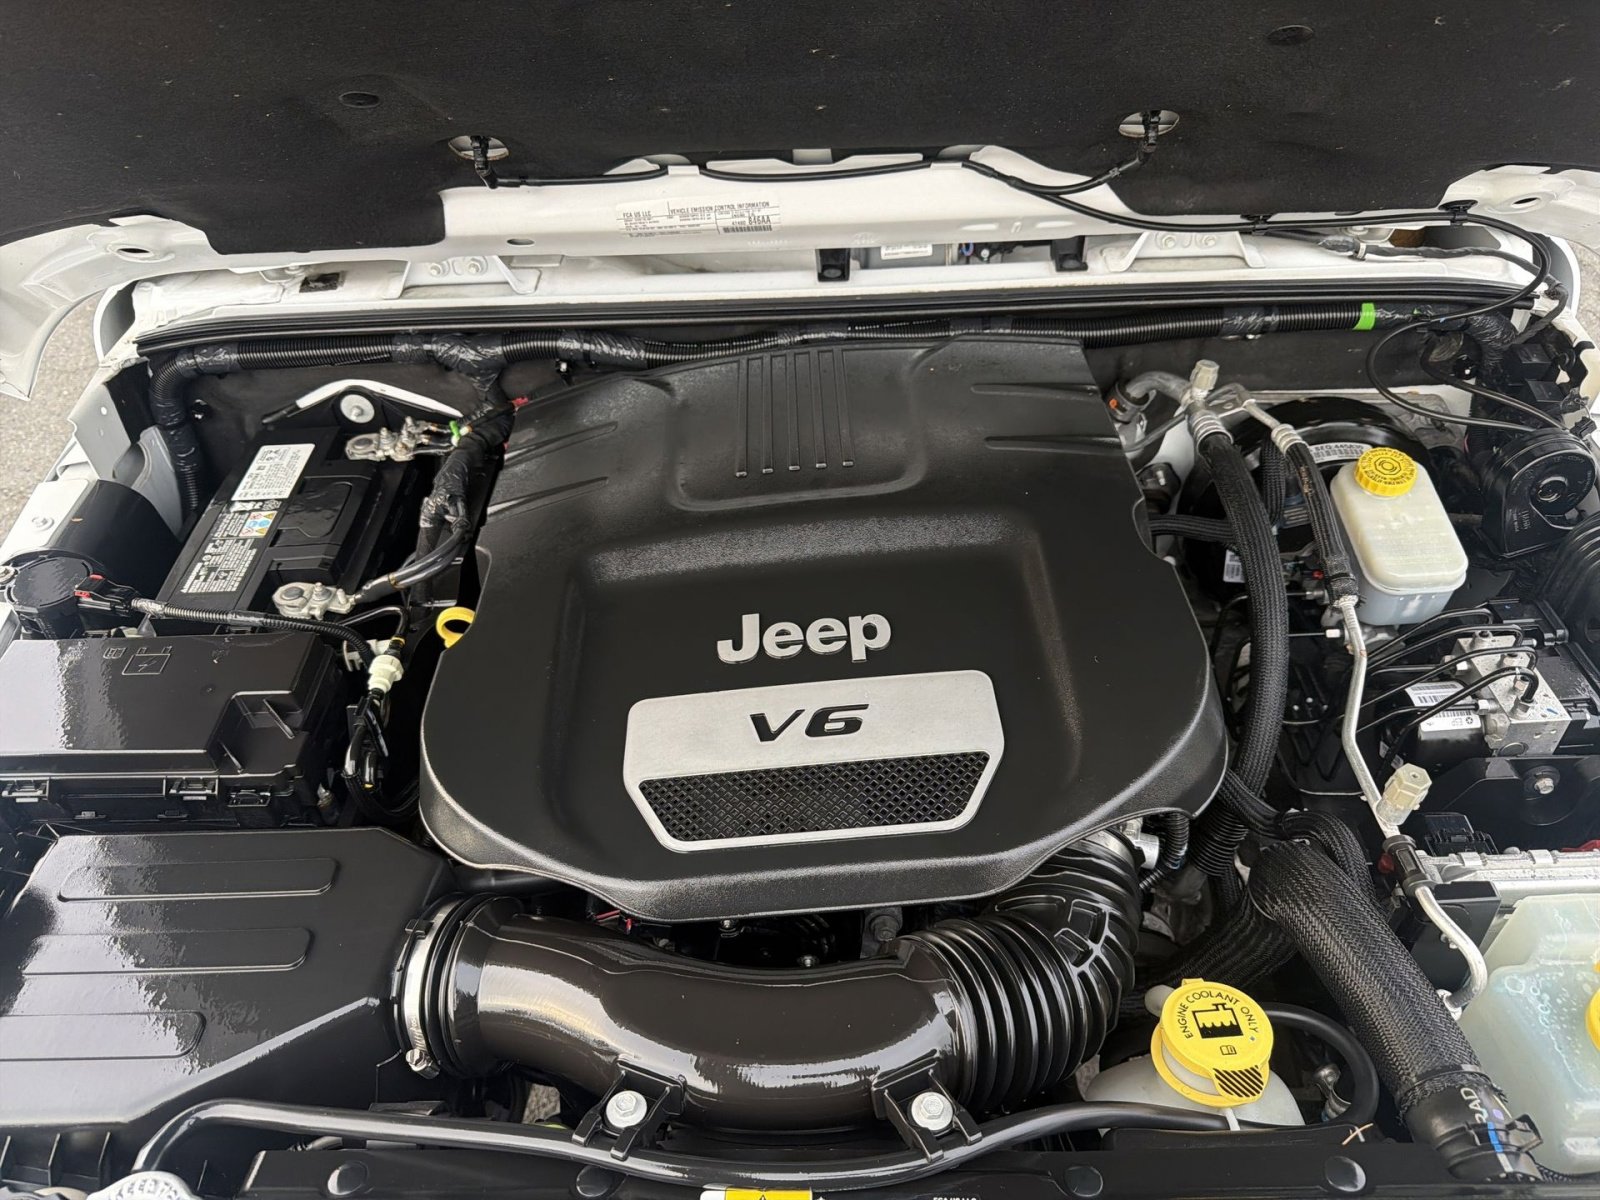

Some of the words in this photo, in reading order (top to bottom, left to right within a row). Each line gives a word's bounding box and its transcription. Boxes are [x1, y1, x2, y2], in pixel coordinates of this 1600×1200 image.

[670, 207, 689, 215] VEHICLE
[690, 205, 713, 213] EMISSION
[736, 201, 770, 209] INFORMATION
[717, 613, 892, 664] Jeep
[749, 703, 870, 742] V6
[1178, 1003, 1193, 1039] ENGINE
[1186, 991, 1240, 1005] COOLANT
[1241, 1007, 1258, 1033] ONLY
